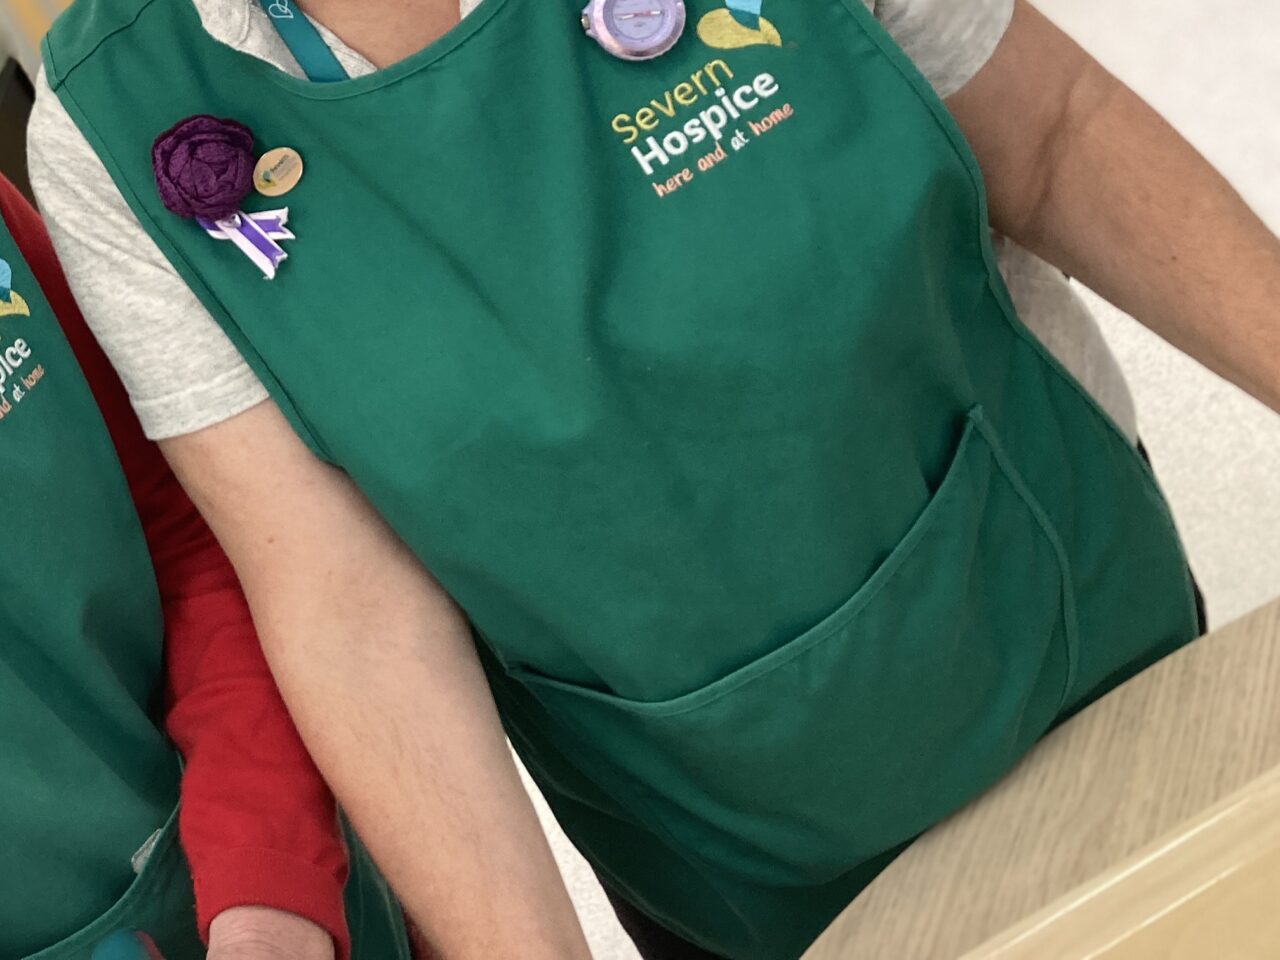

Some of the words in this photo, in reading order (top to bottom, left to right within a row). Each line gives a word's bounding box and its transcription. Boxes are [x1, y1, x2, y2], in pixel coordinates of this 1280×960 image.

[611, 58, 734, 144] Severn
[630, 71, 779, 176] Hospice
[651, 167, 694, 199] here
[697, 141, 728, 172] and
[730, 128, 750, 152] at
[747, 102, 794, 137] home
[12, 383, 26, 404] at
